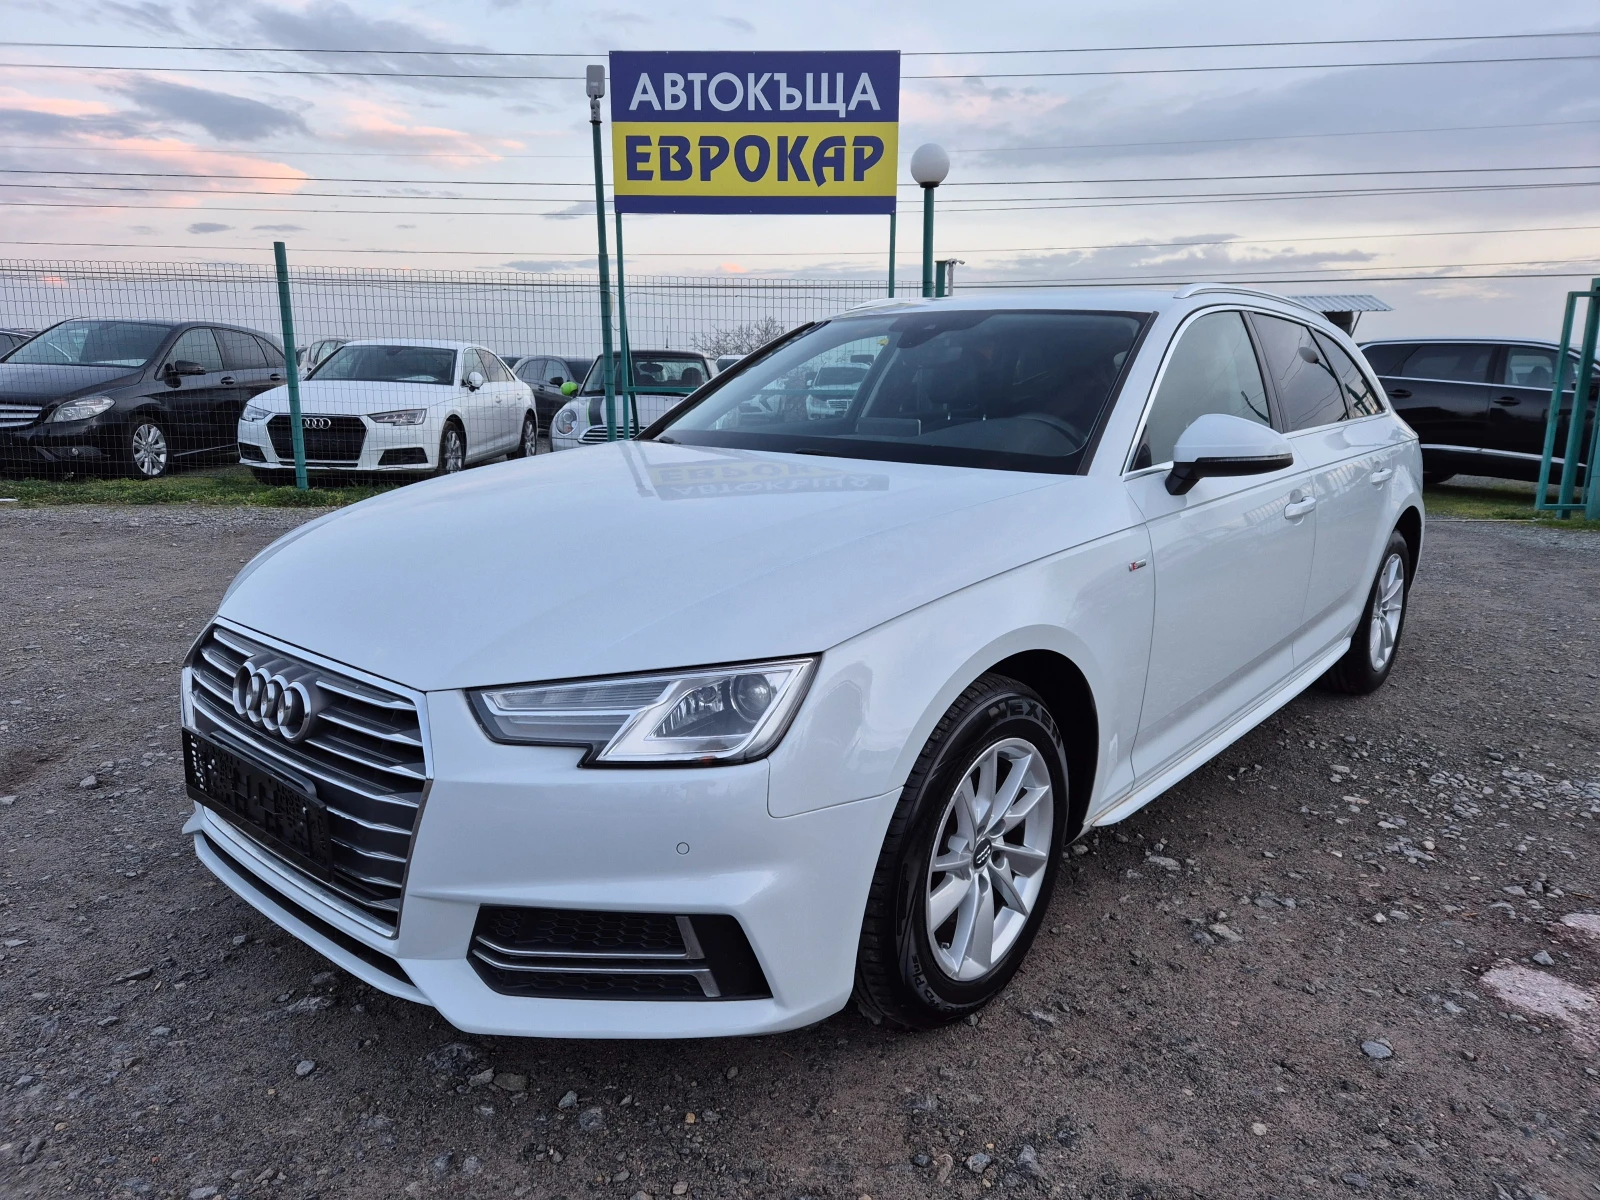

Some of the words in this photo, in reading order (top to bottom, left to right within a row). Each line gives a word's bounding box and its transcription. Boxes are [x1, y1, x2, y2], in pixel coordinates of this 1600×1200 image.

[628, 72, 881, 118] АВТОКЪЩА
[625, 134, 885, 187] ЕВРОКАР
[987, 698, 1061, 749] NEXEN
